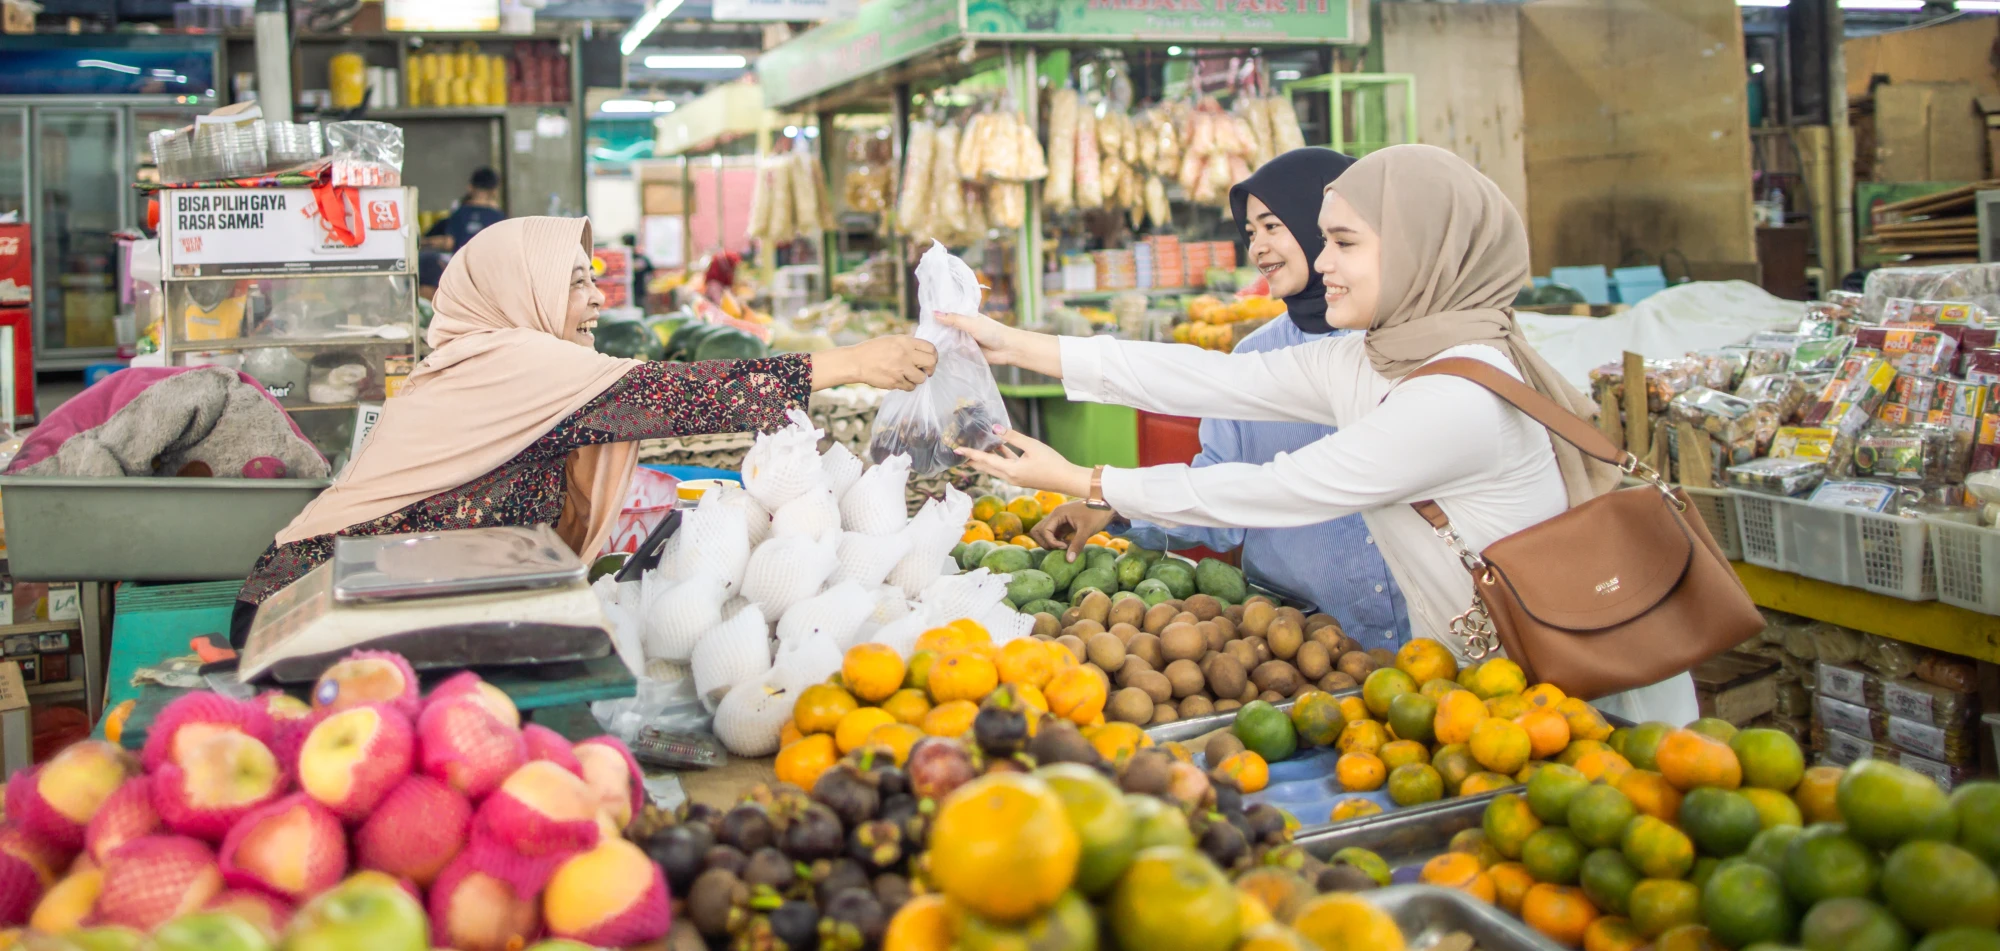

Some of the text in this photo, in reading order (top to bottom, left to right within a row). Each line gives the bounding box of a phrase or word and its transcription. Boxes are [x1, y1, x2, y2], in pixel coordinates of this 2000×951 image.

[178, 196, 210, 212] BISA
[213, 195, 251, 211] PILIH
[252, 194, 286, 211] GAYA
[178, 212, 264, 230] RASA SAMA!
[1595, 577, 1619, 591] GUESS
